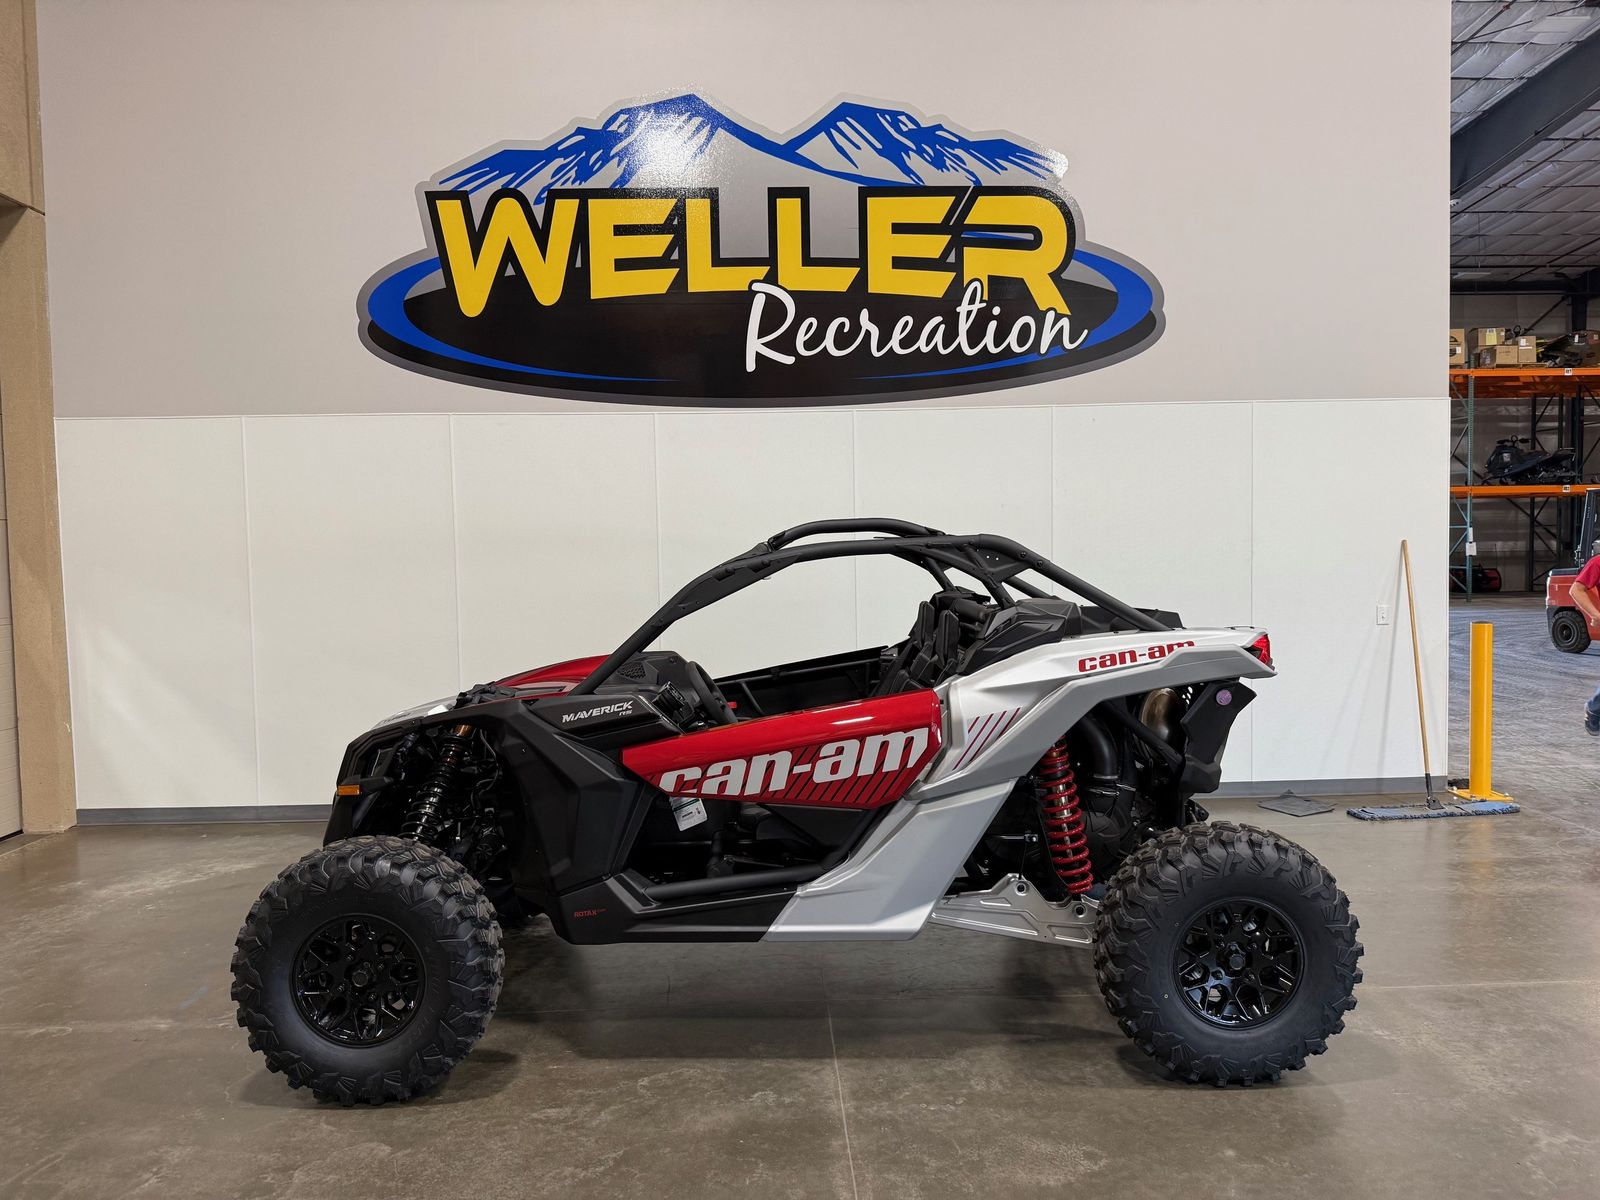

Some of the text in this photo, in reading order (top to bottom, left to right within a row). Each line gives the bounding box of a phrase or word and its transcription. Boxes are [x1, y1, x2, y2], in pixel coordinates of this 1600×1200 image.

[434, 194, 1072, 318] WELLER
[745, 280, 1089, 373] Recreation
[562, 701, 633, 723] MAVERICK
[658, 727, 929, 796] can-am
